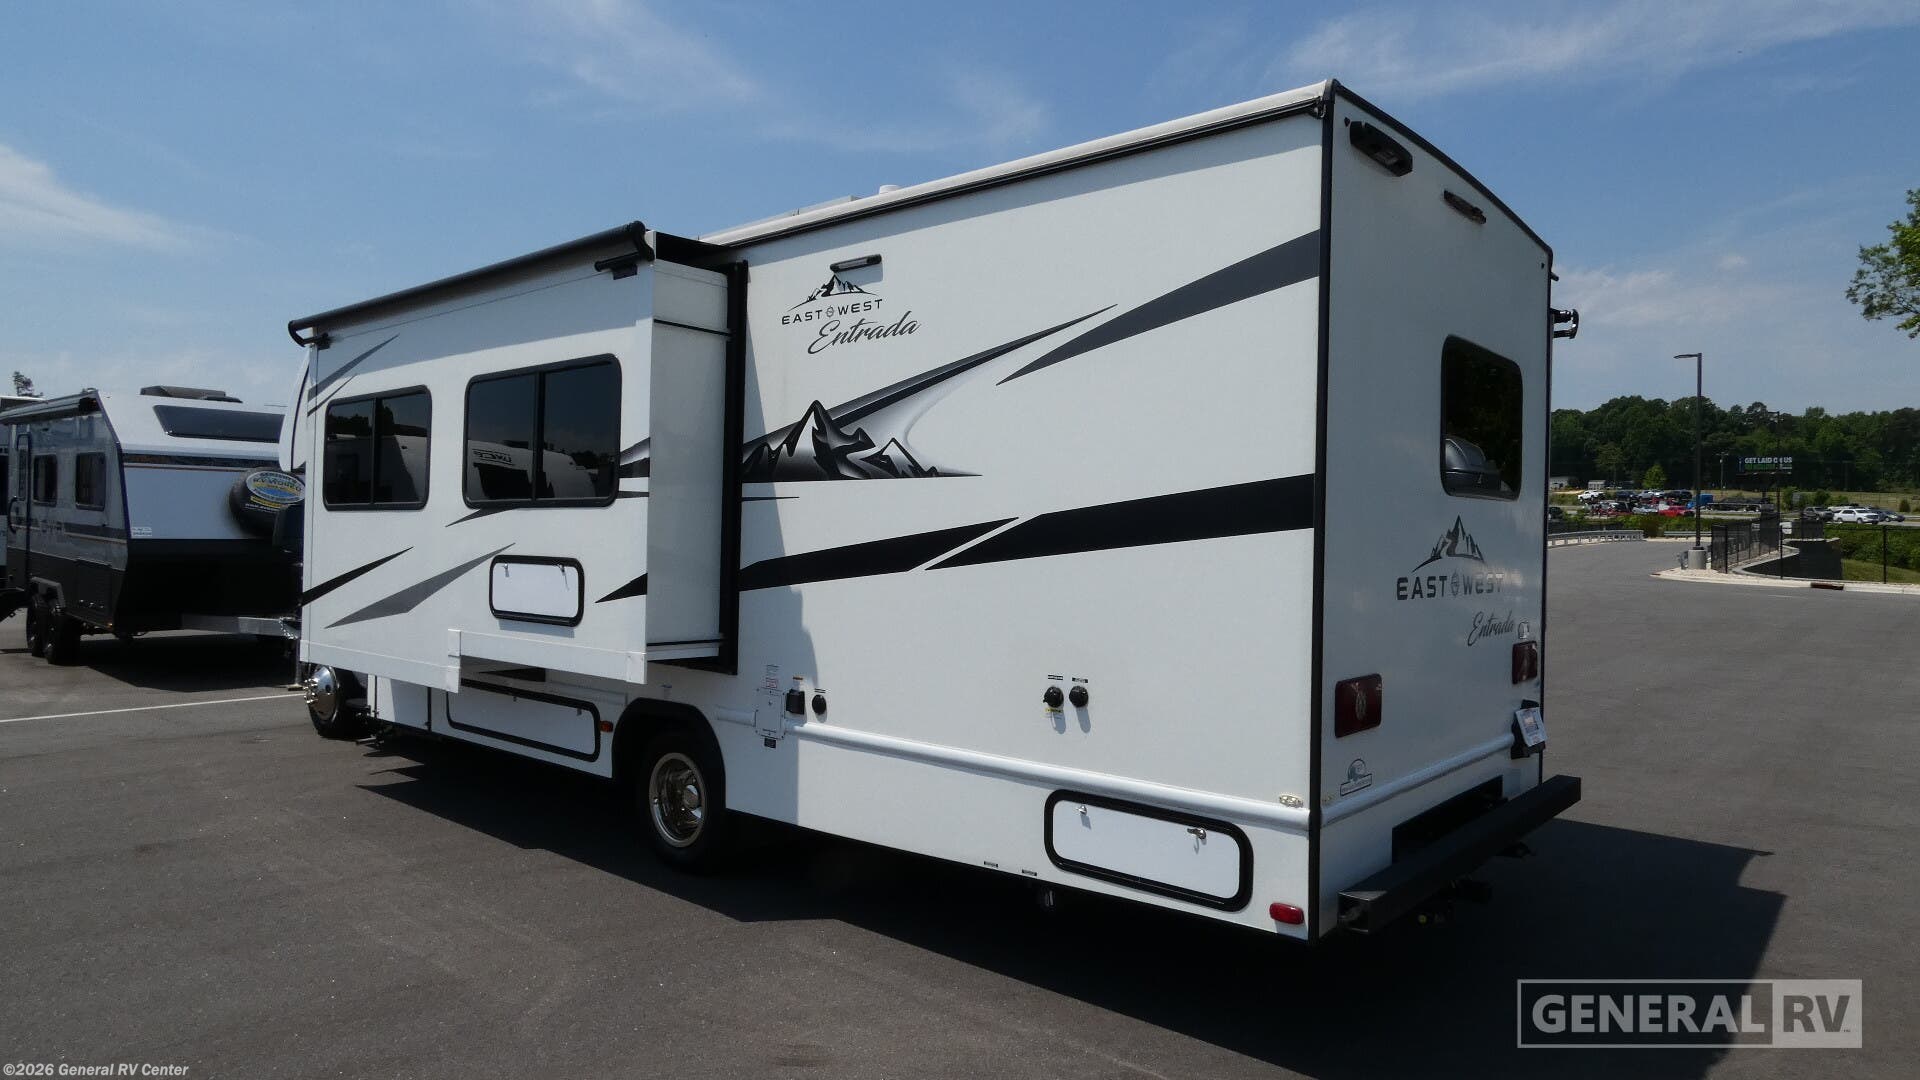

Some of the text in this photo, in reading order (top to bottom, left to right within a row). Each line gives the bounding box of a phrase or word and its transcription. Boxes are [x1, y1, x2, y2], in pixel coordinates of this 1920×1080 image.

[781, 298, 884, 326] EAST WEST
[807, 310, 922, 355] Entrada
[1396, 572, 1505, 601] EAST WEST
[1467, 610, 1514, 647] Entrada
